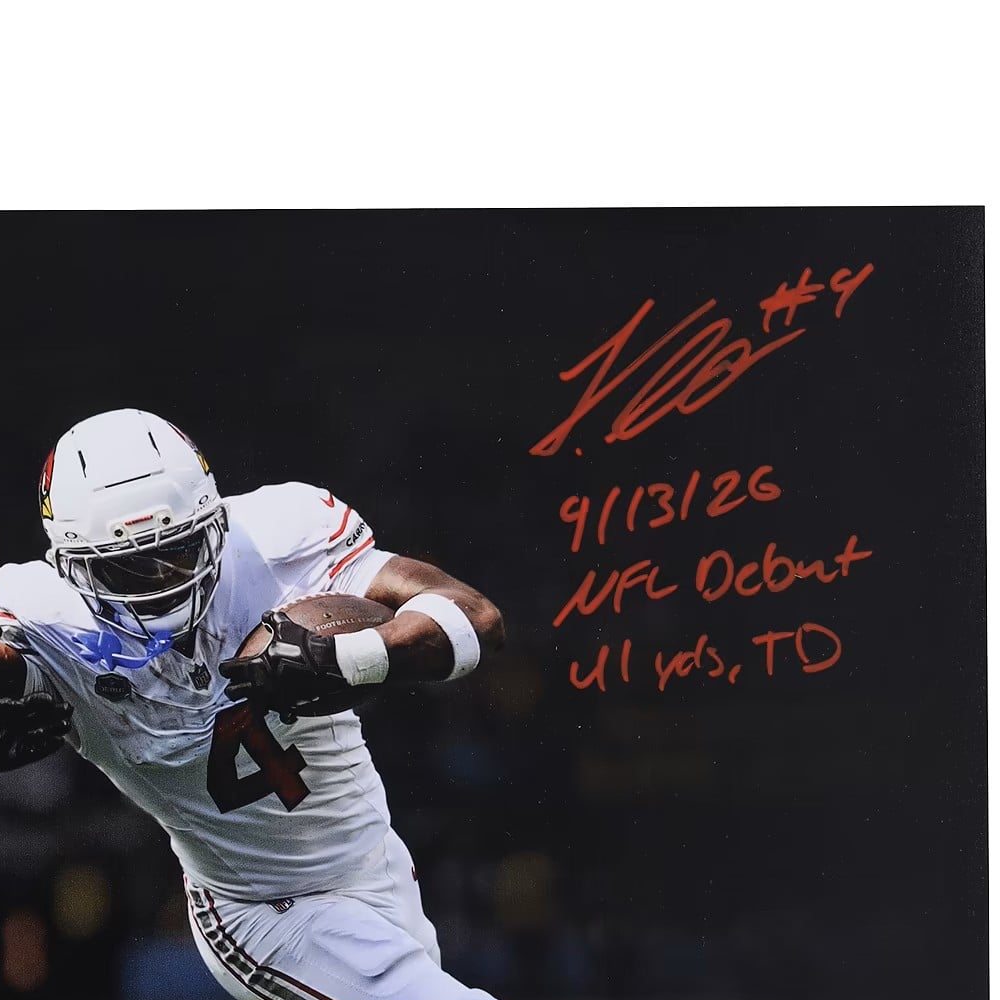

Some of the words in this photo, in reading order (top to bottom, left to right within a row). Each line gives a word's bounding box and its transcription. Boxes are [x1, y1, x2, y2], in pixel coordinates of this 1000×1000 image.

[553, 560, 678, 628] NFL
[696, 536, 873, 601] Debut
[753, 624, 842, 676] TD
[207, 702, 311, 814] 4
